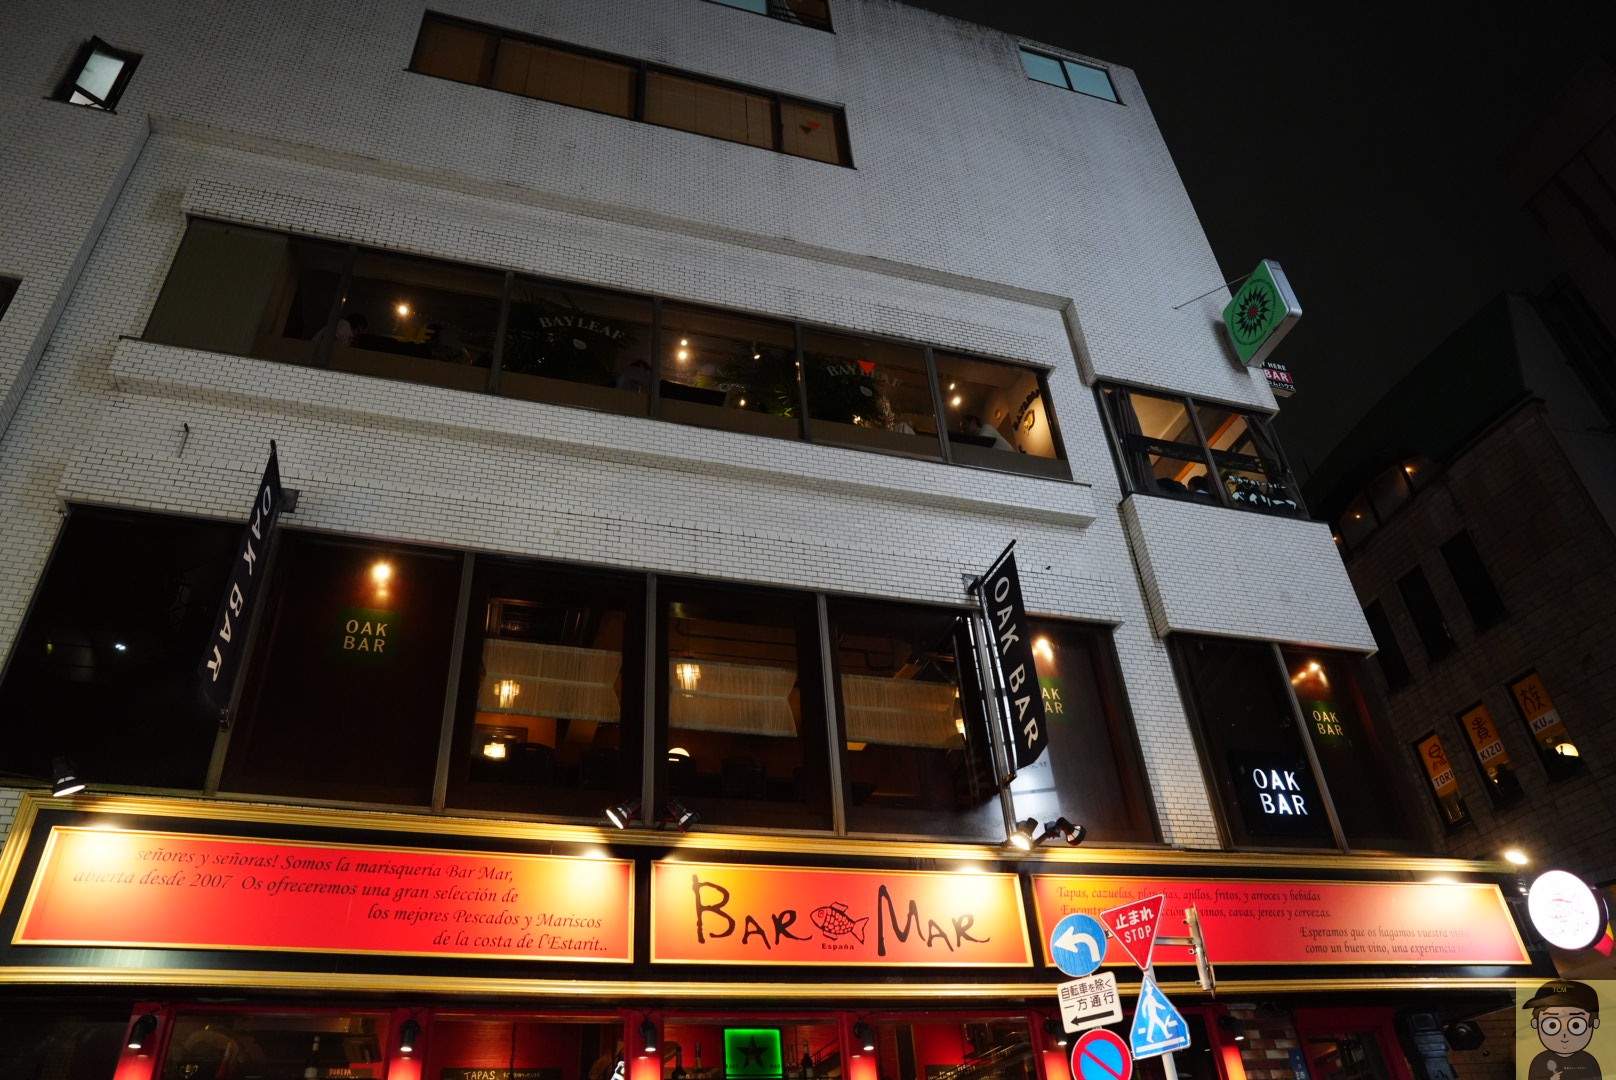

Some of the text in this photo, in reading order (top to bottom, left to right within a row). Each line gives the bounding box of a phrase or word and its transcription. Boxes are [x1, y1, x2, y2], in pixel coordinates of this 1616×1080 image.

[1264, 369, 1289, 382] BAR
[206, 485, 272, 682] OAK BAR
[345, 619, 388, 637] OAK
[343, 636, 386, 653] BAR
[994, 576, 1020, 654] OAK
[1008, 663, 1040, 750] BAR
[1042, 687, 1060, 701] AK
[1044, 701, 1064, 714] AR
[1312, 710, 1339, 724] OAK
[1532, 717, 1548, 732] KU
[1317, 722, 1344, 736] BAR
[1479, 742, 1502, 761] KIZO
[1252, 768, 1301, 791] OAK
[1433, 769, 1454, 787] TORI
[1260, 792, 1309, 816] BAR
[135, 847, 513, 882] señores y señoras! Somos la marisquería Bar Mar,
[139, 868, 186, 887] desde
[189, 873, 233, 889] 2007
[241, 875, 263, 891] Os
[267, 876, 358, 897] ofreceremos
[362, 885, 391, 898] una
[392, 887, 430, 903] gran
[433, 885, 497, 902] selección
[501, 887, 519, 903] de
[1056, 886, 1089, 901] Tapas,
[1091, 886, 1135, 901] cazuelas,
[1183, 888, 1213, 903] ajillos,
[1215, 888, 1241, 903] fritos,
[1243, 892, 1251, 904] y
[1251, 891, 1283, 901] arroces
[1282, 892, 1288, 904] y
[1289, 889, 1322, 901] bebidas
[368, 903, 602, 931] los mejores Pescados y Mariscos
[1115, 905, 1155, 931] 止まれ
[1200, 908, 1227, 919] vinos,
[1229, 908, 1256, 919] cavas,
[1258, 908, 1285, 920] jereces
[1287, 909, 1294, 921] y
[1294, 908, 1332, 919] cervezas.
[433, 929, 451, 946] de
[455, 930, 469, 947] la
[474, 936, 512, 949] costa
[516, 932, 534, 949] de
[1124, 924, 1152, 944] STOP
[1300, 926, 1349, 941] Esperamos
[1351, 928, 1366, 941] que
[1367, 928, 1377, 938] os
[1379, 925, 1416, 941] hagamos
[821, 942, 855, 951] España
[1305, 944, 1328, 954] como
[1330, 944, 1342, 953] un
[1344, 940, 1366, 953] buen
[1368, 942, 1390, 955] vino,
[1391, 944, 1409, 954] una
[1410, 942, 1457, 957] experiencia
[1060, 978, 1113, 1000] 自転車を除く
[1064, 991, 1115, 1012] 一方通行
